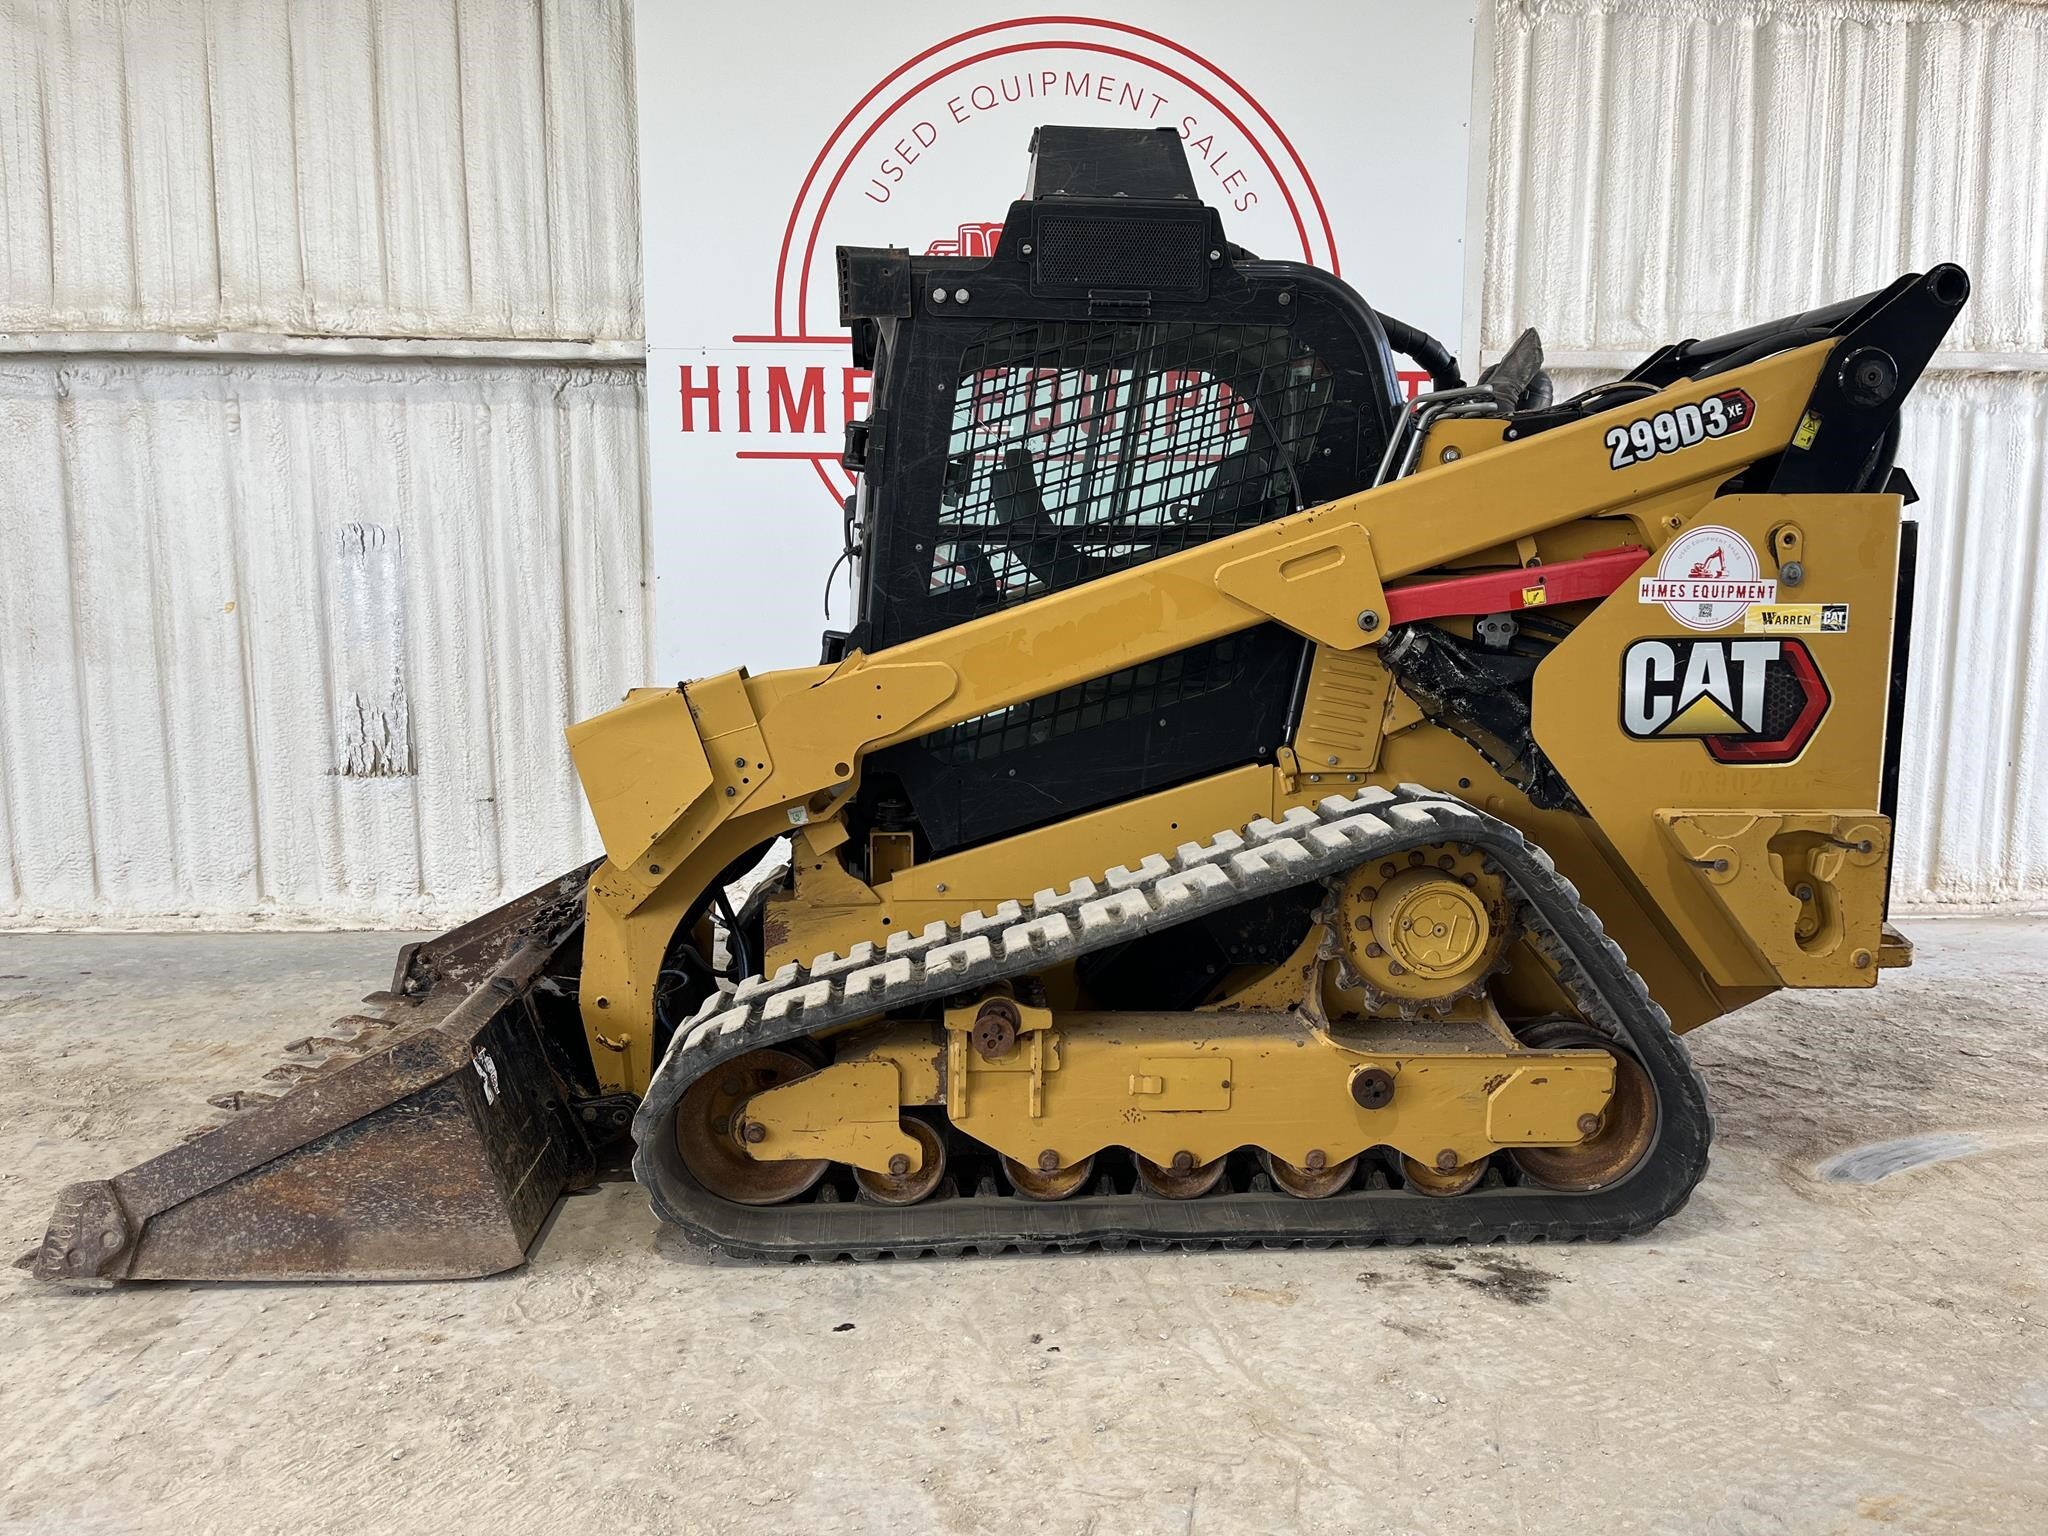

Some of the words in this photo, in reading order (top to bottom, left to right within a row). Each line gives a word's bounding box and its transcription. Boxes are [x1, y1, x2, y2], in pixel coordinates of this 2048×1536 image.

[865, 121, 936, 203] USED
[947, 71, 1169, 124] EQUIPMENT
[1180, 116, 1258, 212] SALES
[679, 365, 875, 434] HIME
[1606, 397, 1728, 468] 299D3
[1726, 403, 1744, 419] XE
[1641, 583, 1686, 598] HIMES
[1692, 584, 1775, 600] EQUIPMENT
[1762, 611, 1812, 626] WARREN
[1823, 610, 1845, 626] CAT
[1624, 641, 1781, 735] CAT
